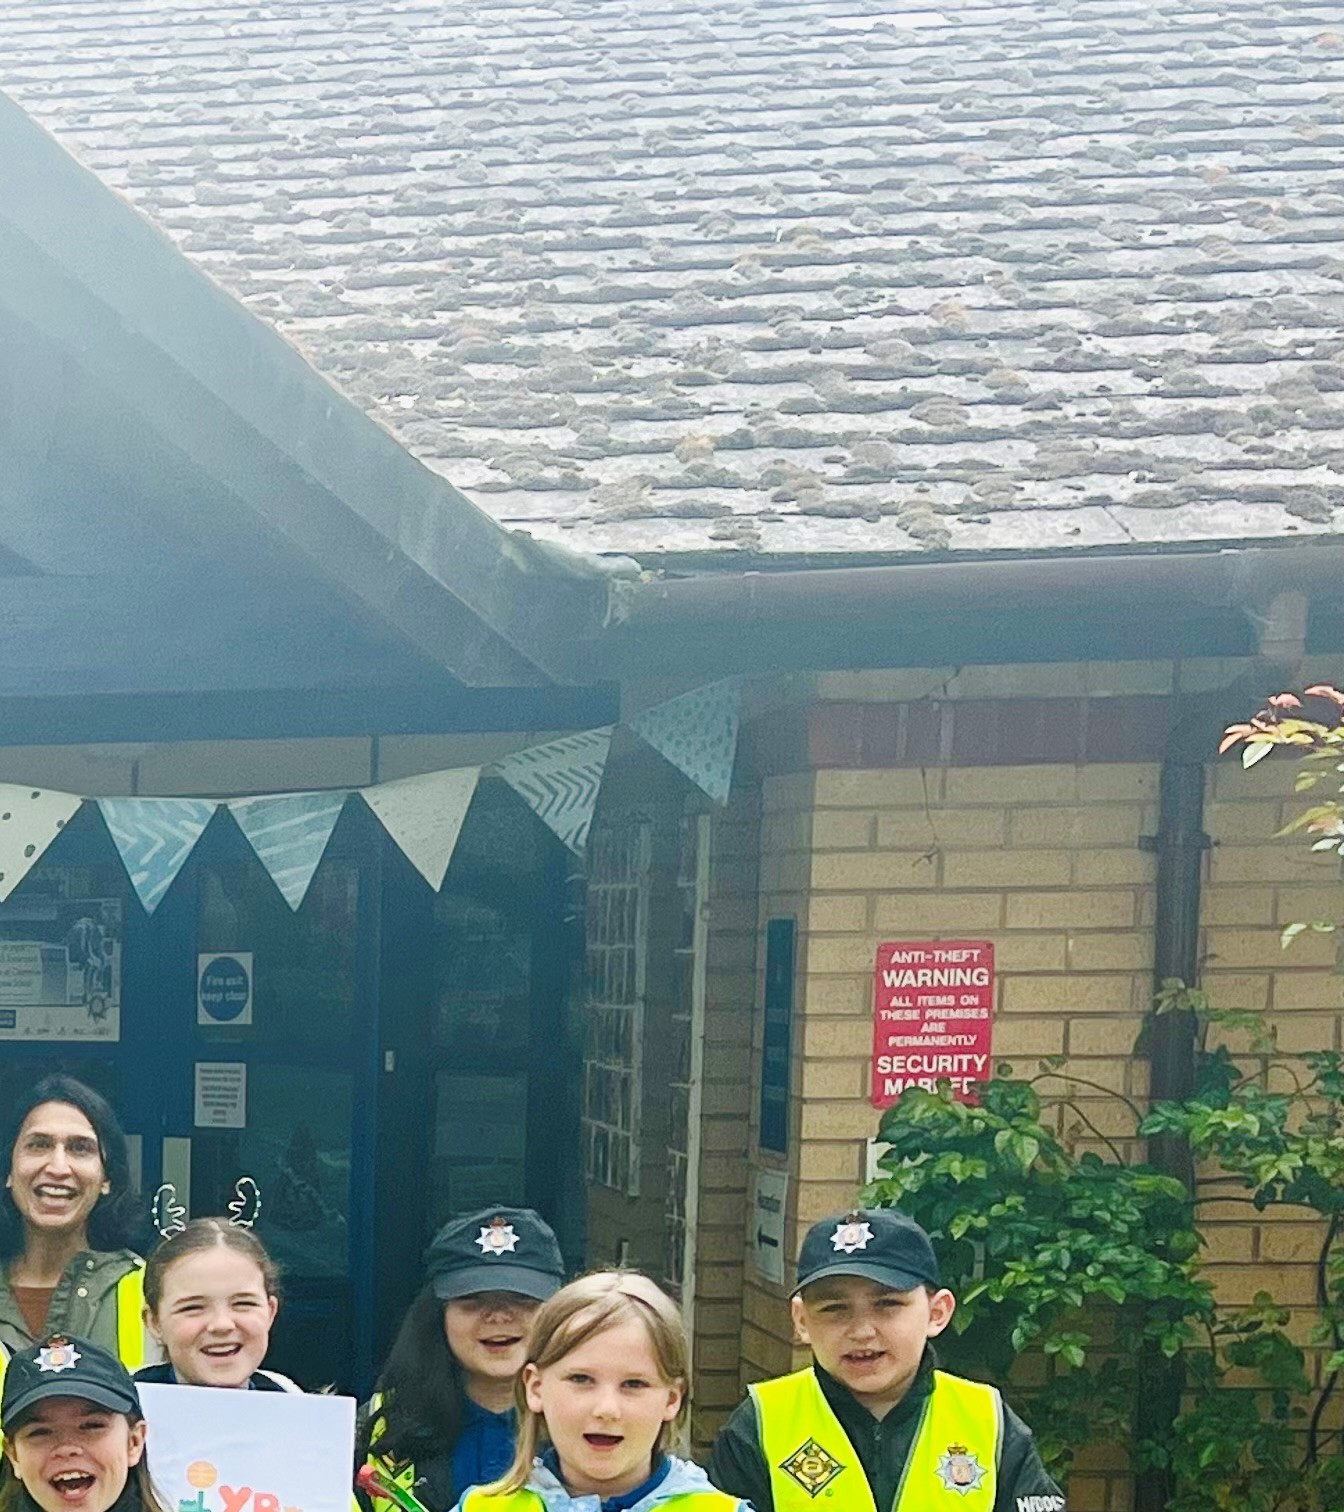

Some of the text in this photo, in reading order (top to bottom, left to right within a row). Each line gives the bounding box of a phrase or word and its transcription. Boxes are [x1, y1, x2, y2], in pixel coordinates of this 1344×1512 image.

[890, 949, 982, 964] ANTI-THEFT
[882, 967, 989, 988] WARNING
[890, 994, 979, 1007] ALL ITEMS ON
[880, 1008, 989, 1021] THESE PREMISES
[920, 1022, 947, 1033] ARE
[888, 1034, 977, 1047] PERMANENTLY
[877, 1053, 988, 1075] SECURITY
